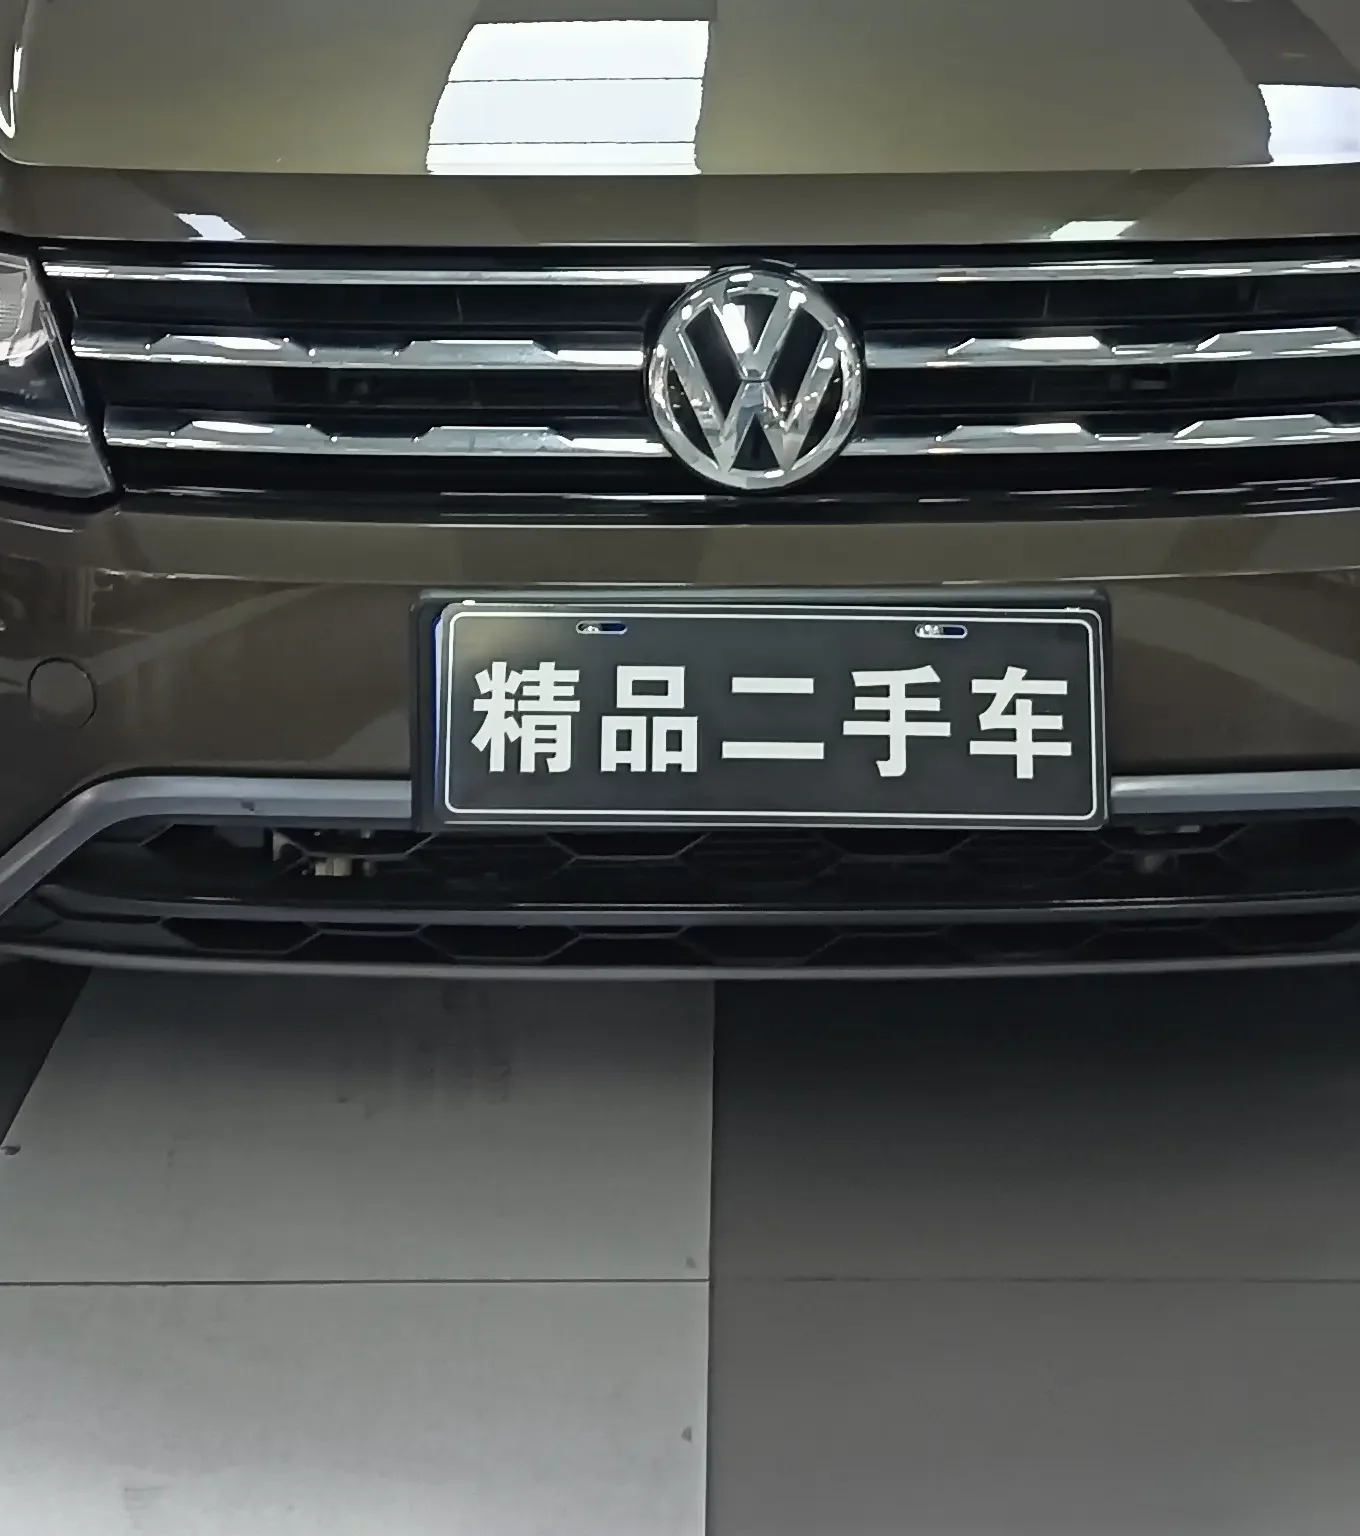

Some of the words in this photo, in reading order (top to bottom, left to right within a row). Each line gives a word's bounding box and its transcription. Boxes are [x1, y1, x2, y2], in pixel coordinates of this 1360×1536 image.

[472, 661, 1073, 780] 精品二手车
